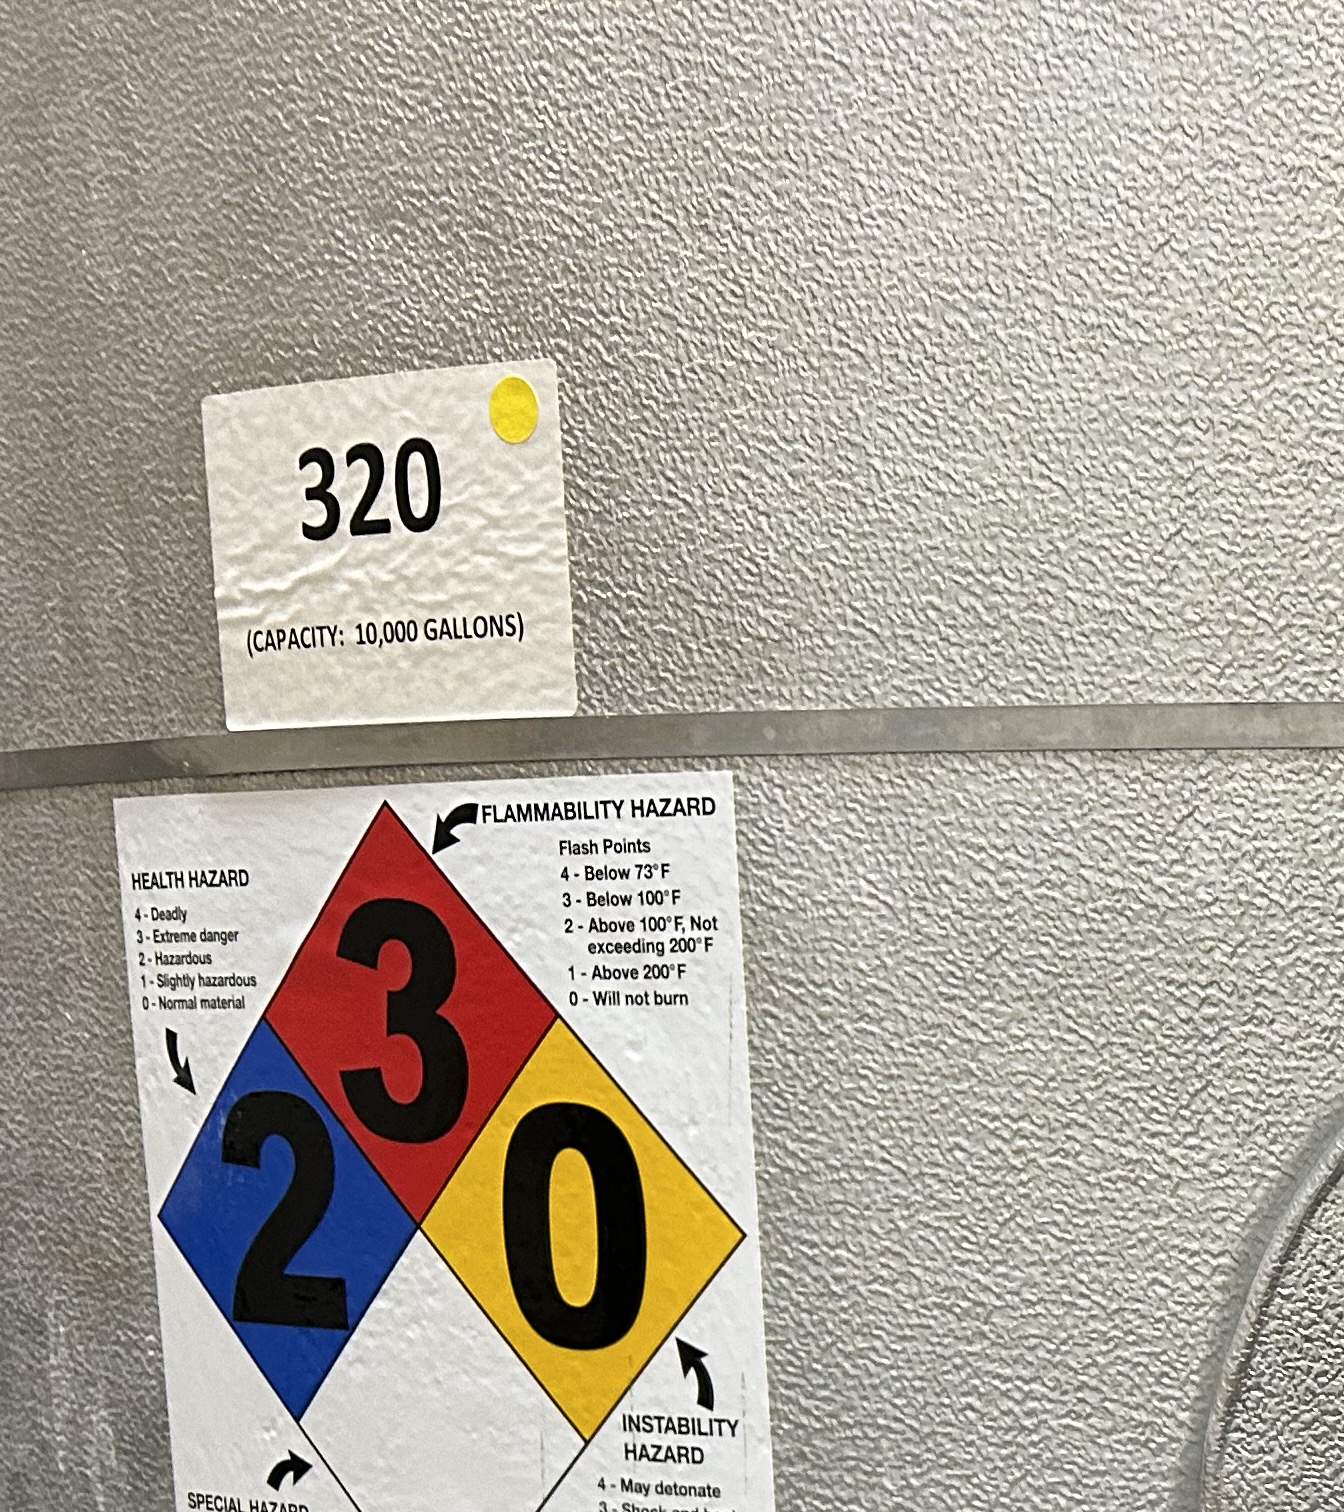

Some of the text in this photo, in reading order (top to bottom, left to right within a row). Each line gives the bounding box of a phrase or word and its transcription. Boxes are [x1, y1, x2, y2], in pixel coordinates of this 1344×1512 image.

[299, 437, 441, 541] 320
[247, 611, 524, 659] (CAPACITY: 10,000 GALLONS)
[482, 797, 716, 824] FLAMMABILITY HAZARD
[559, 838, 651, 856] Flash Points
[131, 869, 249, 891] HEALTH HAZARD
[560, 866, 569, 882] 4
[584, 865, 630, 881] Below
[562, 892, 572, 908] 3
[586, 891, 632, 907] Below
[134, 908, 141, 922] 4
[151, 906, 187, 924] Deadly
[564, 918, 574, 933] 2
[588, 917, 635, 933] Above
[690, 915, 718, 931] Not
[136, 929, 144, 944] 3
[153, 929, 197, 944] Extreme
[199, 928, 239, 946] danger
[588, 938, 665, 957] exceeding
[138, 952, 146, 966] 2
[155, 951, 213, 966] Hazardous
[141, 974, 146, 988] 1
[157, 973, 195, 991] Slightly
[198, 972, 257, 987] hazardous
[568, 965, 575, 981] 1
[592, 965, 639, 980] Above
[142, 996, 149, 1011] 0
[158, 995, 197, 1010] Normal
[200, 995, 245, 1010] material
[569, 991, 578, 1006] 0
[592, 991, 620, 1006] Will
[625, 991, 650, 1006] not
[654, 990, 689, 1006] burn
[336, 897, 471, 1144] 3
[221, 1090, 350, 1331] 2
[502, 1101, 647, 1351] 0
[622, 1413, 739, 1438] INSTABILITY
[624, 1442, 704, 1465] HAZARD
[597, 1477, 606, 1491] 4
[620, 1477, 650, 1497] May
[655, 1480, 721, 1498] detonate
